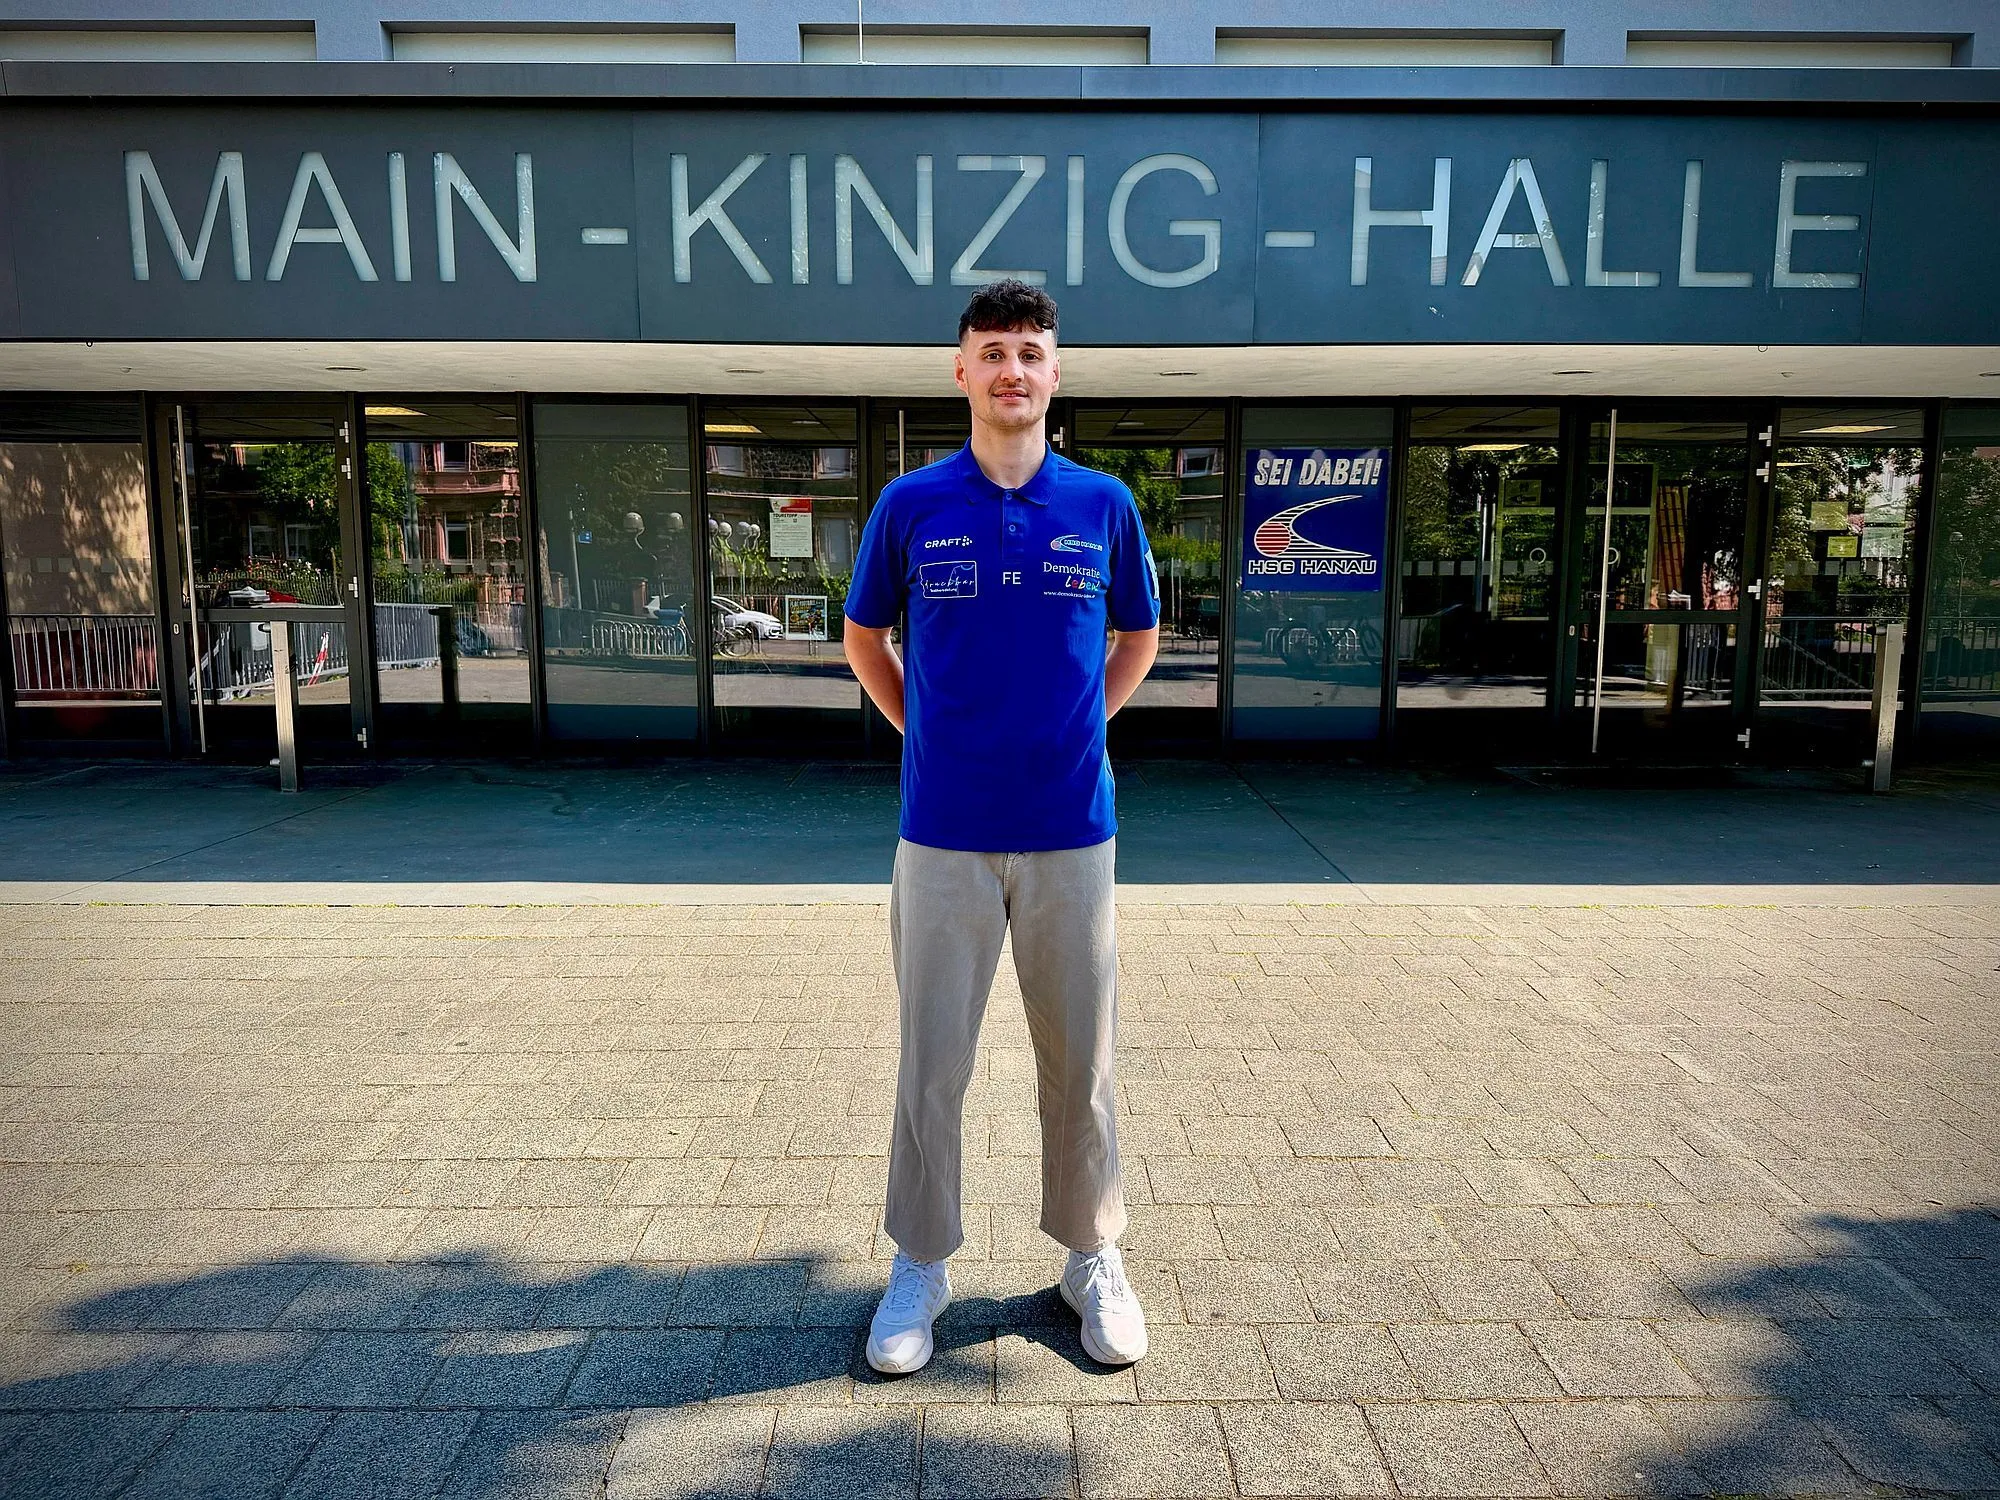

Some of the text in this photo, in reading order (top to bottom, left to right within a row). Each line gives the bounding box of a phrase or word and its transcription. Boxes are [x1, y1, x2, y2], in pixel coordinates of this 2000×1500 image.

[123, 151, 537, 283] MAIN
[669, 152, 1223, 288] KINZIG
[1350, 156, 1869, 289] HALLE
[1254, 458, 1382, 485] SEI DABEI!
[925, 538, 962, 549] CRAFT
[1043, 561, 1101, 579] Demokratie
[1248, 560, 1377, 574] HSG HANAU
[1003, 571, 1021, 585] FE
